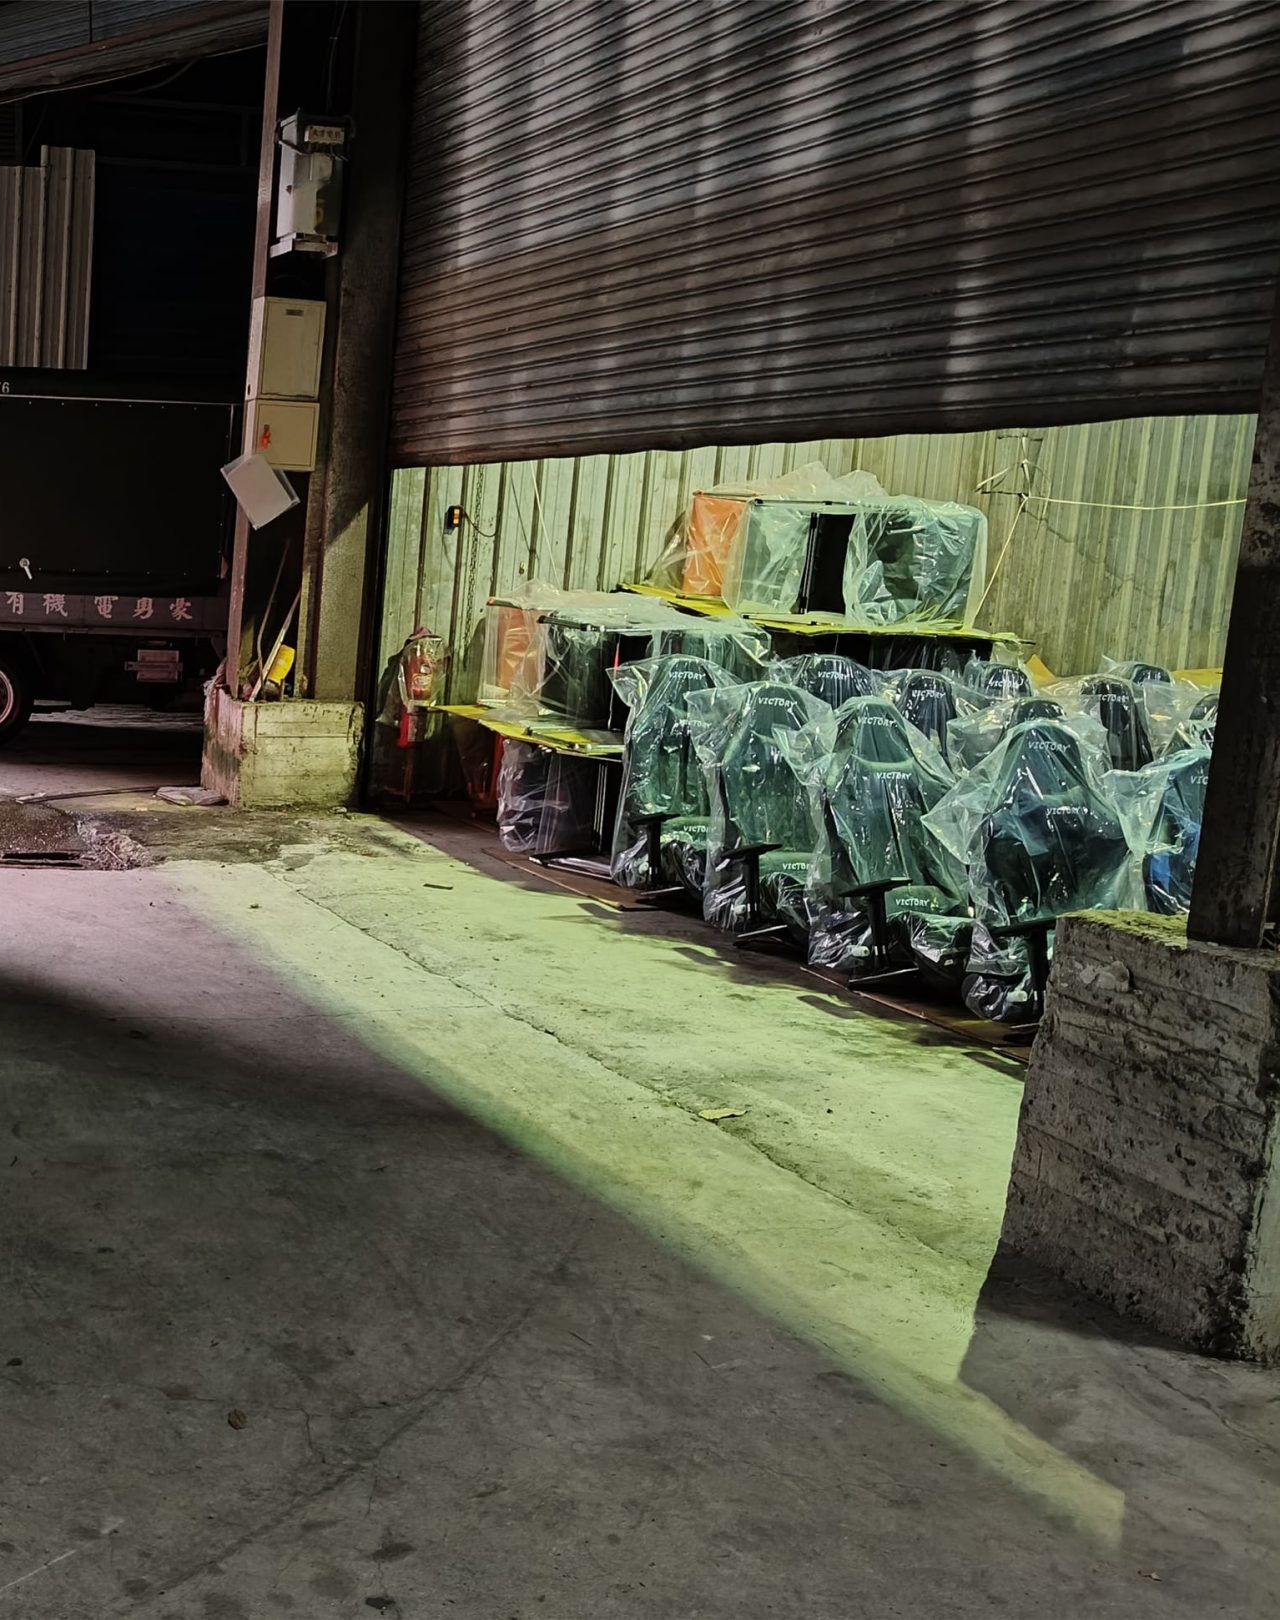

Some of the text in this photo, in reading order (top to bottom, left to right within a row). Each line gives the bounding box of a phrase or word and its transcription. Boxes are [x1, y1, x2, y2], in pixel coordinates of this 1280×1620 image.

[669, 671, 705, 681] VICTORY
[758, 697, 797, 708] VICTORY
[858, 717, 896, 727] VICTORY
[1028, 740, 1070, 752] VICTORY
[876, 772, 912, 781] VICTORY
[895, 898, 930, 907] VICTORY
